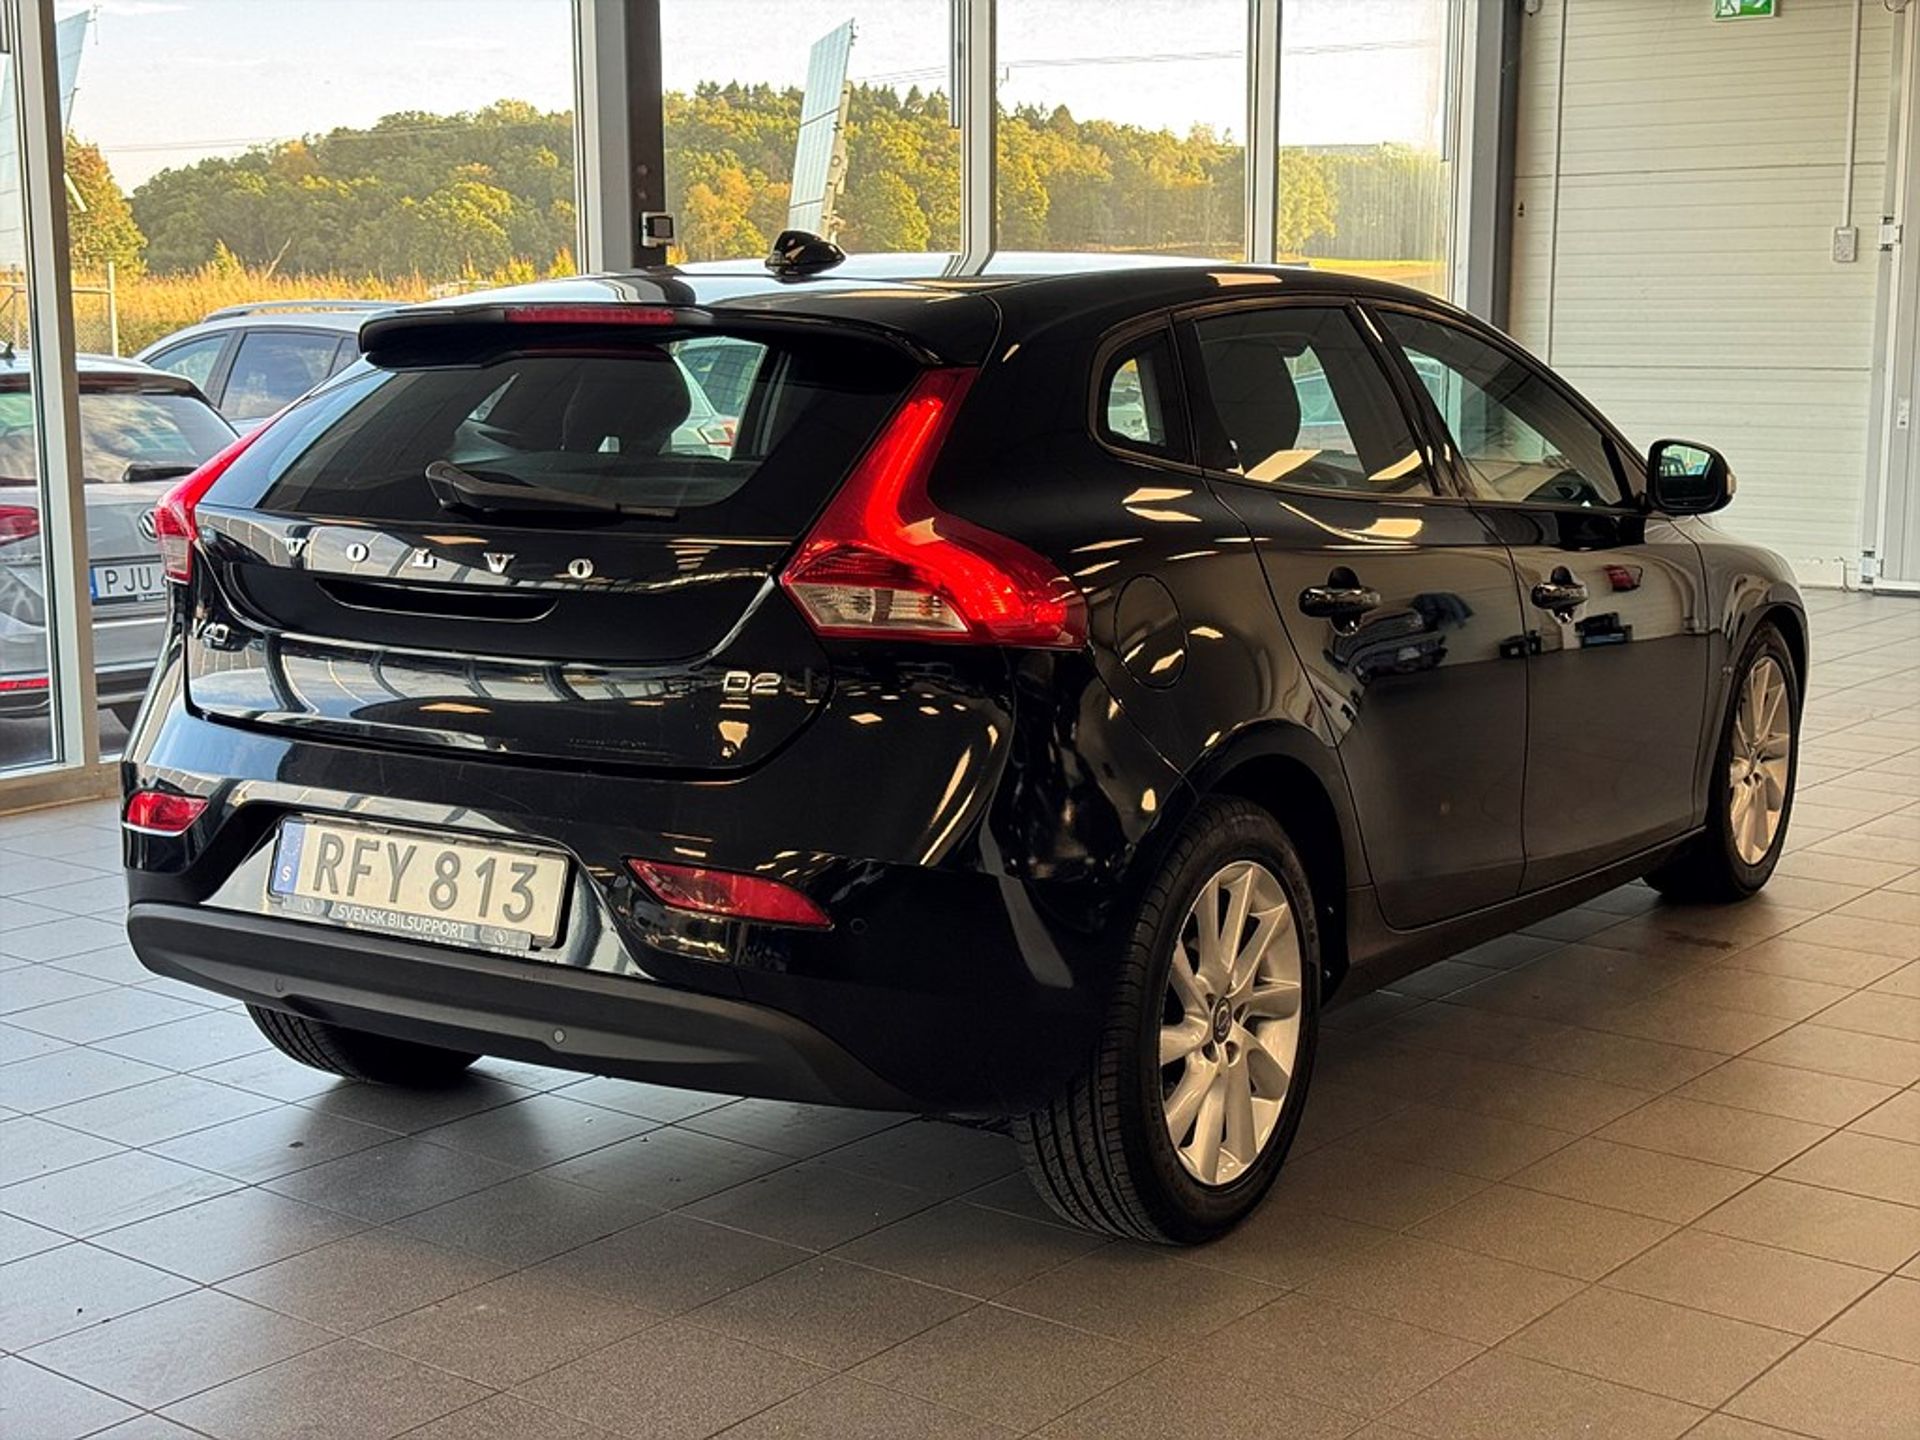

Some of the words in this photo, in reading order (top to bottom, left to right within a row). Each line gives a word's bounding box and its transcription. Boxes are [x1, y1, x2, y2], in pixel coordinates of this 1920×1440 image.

[283, 537, 594, 579] VOLVO
[104, 566, 152, 594] PJU
[723, 671, 781, 694] D2
[281, 867, 291, 882] S
[313, 832, 417, 903] RFY
[429, 851, 538, 923] 813
[337, 903, 386, 927] SVENSK
[387, 912, 467, 939] BILSUPPORT
